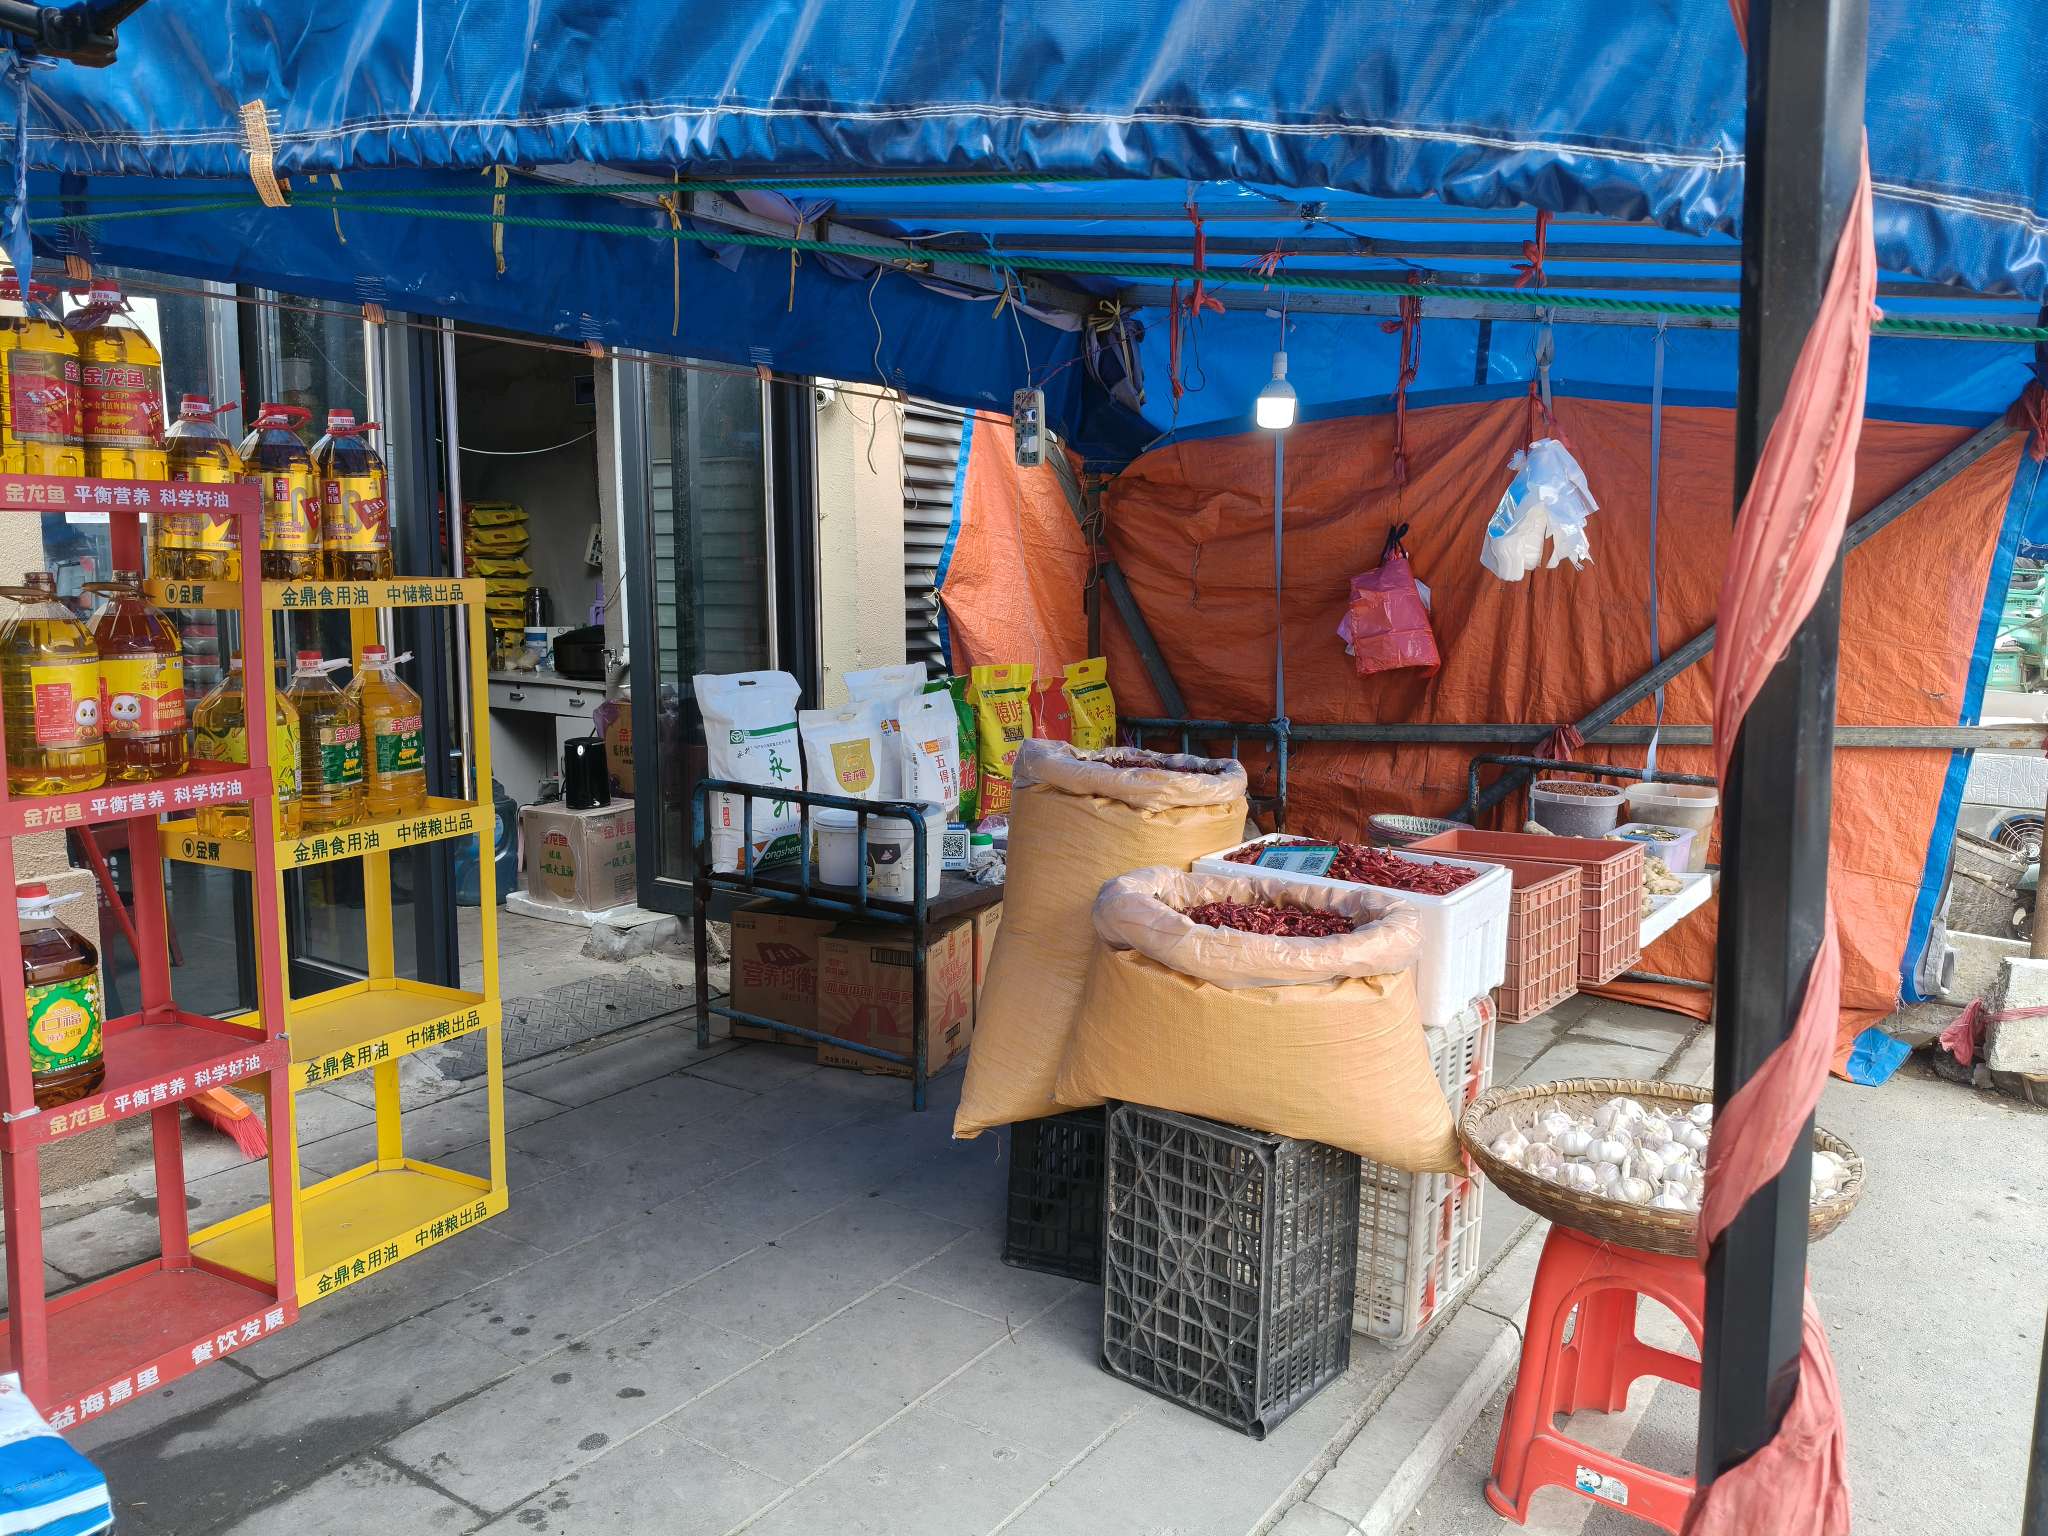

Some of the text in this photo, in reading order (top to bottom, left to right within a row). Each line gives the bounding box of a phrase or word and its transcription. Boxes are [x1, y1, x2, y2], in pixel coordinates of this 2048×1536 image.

[83, 366, 145, 389] 金龙鱼
[5, 484, 230, 508] 金龙鱼 平衡营养 科学好油
[178, 585, 205, 605] 金鼎
[281, 583, 464, 607] 金鼎食用油 中储粮出品
[842, 768, 867, 783] 金龙鱼
[24, 779, 243, 828] 金龙鱼 平衡营养 科学好油
[293, 812, 473, 863] 金鼎食用油 中储粮出品
[195, 841, 220, 862] 金鼎
[40, 1011, 82, 1032] 口福
[304, 1010, 480, 1084] 金鼎食用油 中储粮出品
[49, 1053, 261, 1136] 金龙鱼 平衡营养 科学好油
[317, 1201, 487, 1294] 金鼎食用油 中储粮出品
[49, 1307, 286, 1432] 益海嘉里 餐饮发展
